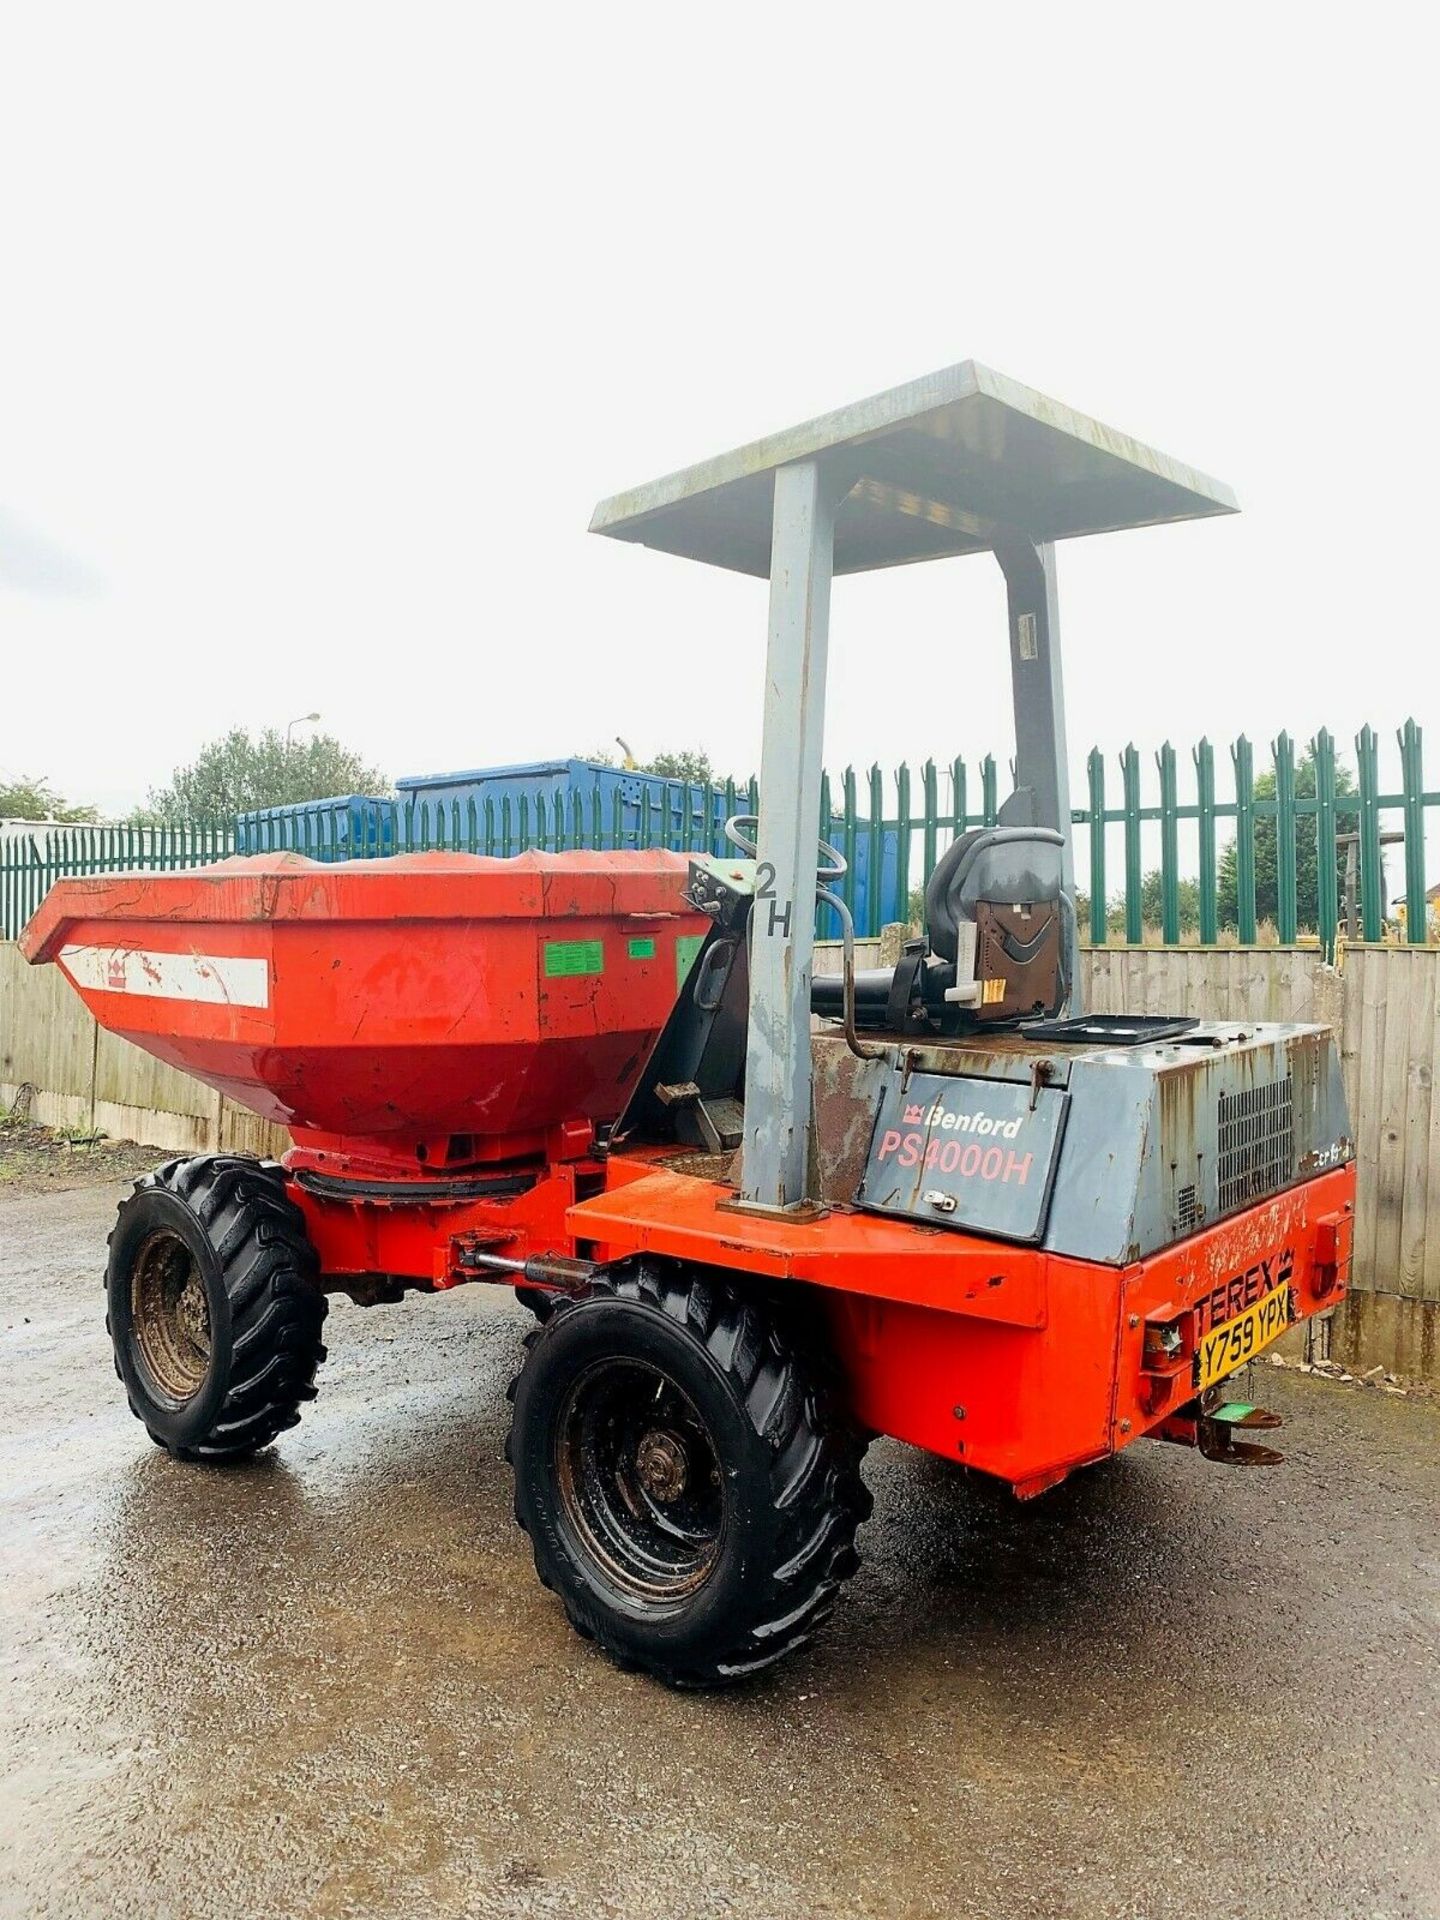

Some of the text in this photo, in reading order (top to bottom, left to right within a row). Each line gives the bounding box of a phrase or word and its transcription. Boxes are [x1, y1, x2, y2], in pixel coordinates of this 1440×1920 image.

[756, 862, 776, 899] 2
[768, 900, 791, 937] H
[925, 1105, 1022, 1139] Benford
[878, 1131, 1033, 1185] PS4000H
[1193, 1256, 1277, 1337] TEREX
[1205, 1290, 1287, 1378] Y759 YPX
